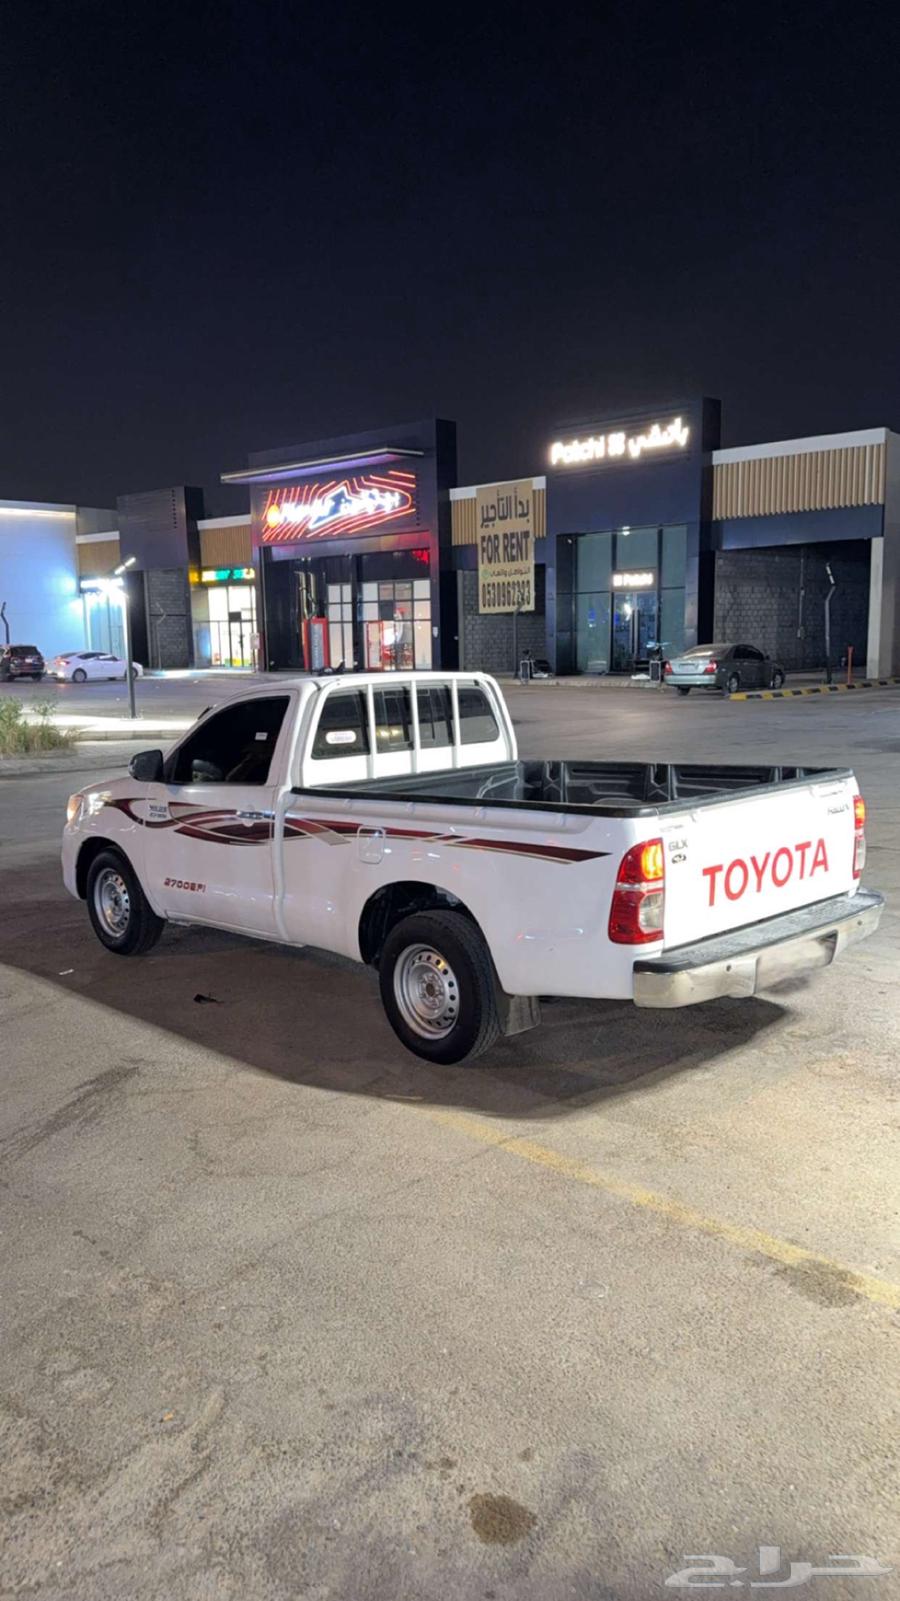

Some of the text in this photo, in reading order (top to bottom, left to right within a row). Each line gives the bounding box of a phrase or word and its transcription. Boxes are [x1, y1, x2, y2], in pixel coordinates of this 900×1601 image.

[480, 487, 530, 529] بدأ التأجير
[480, 530, 530, 565] FOR RENT
[702, 838, 829, 907] TOYOTA
